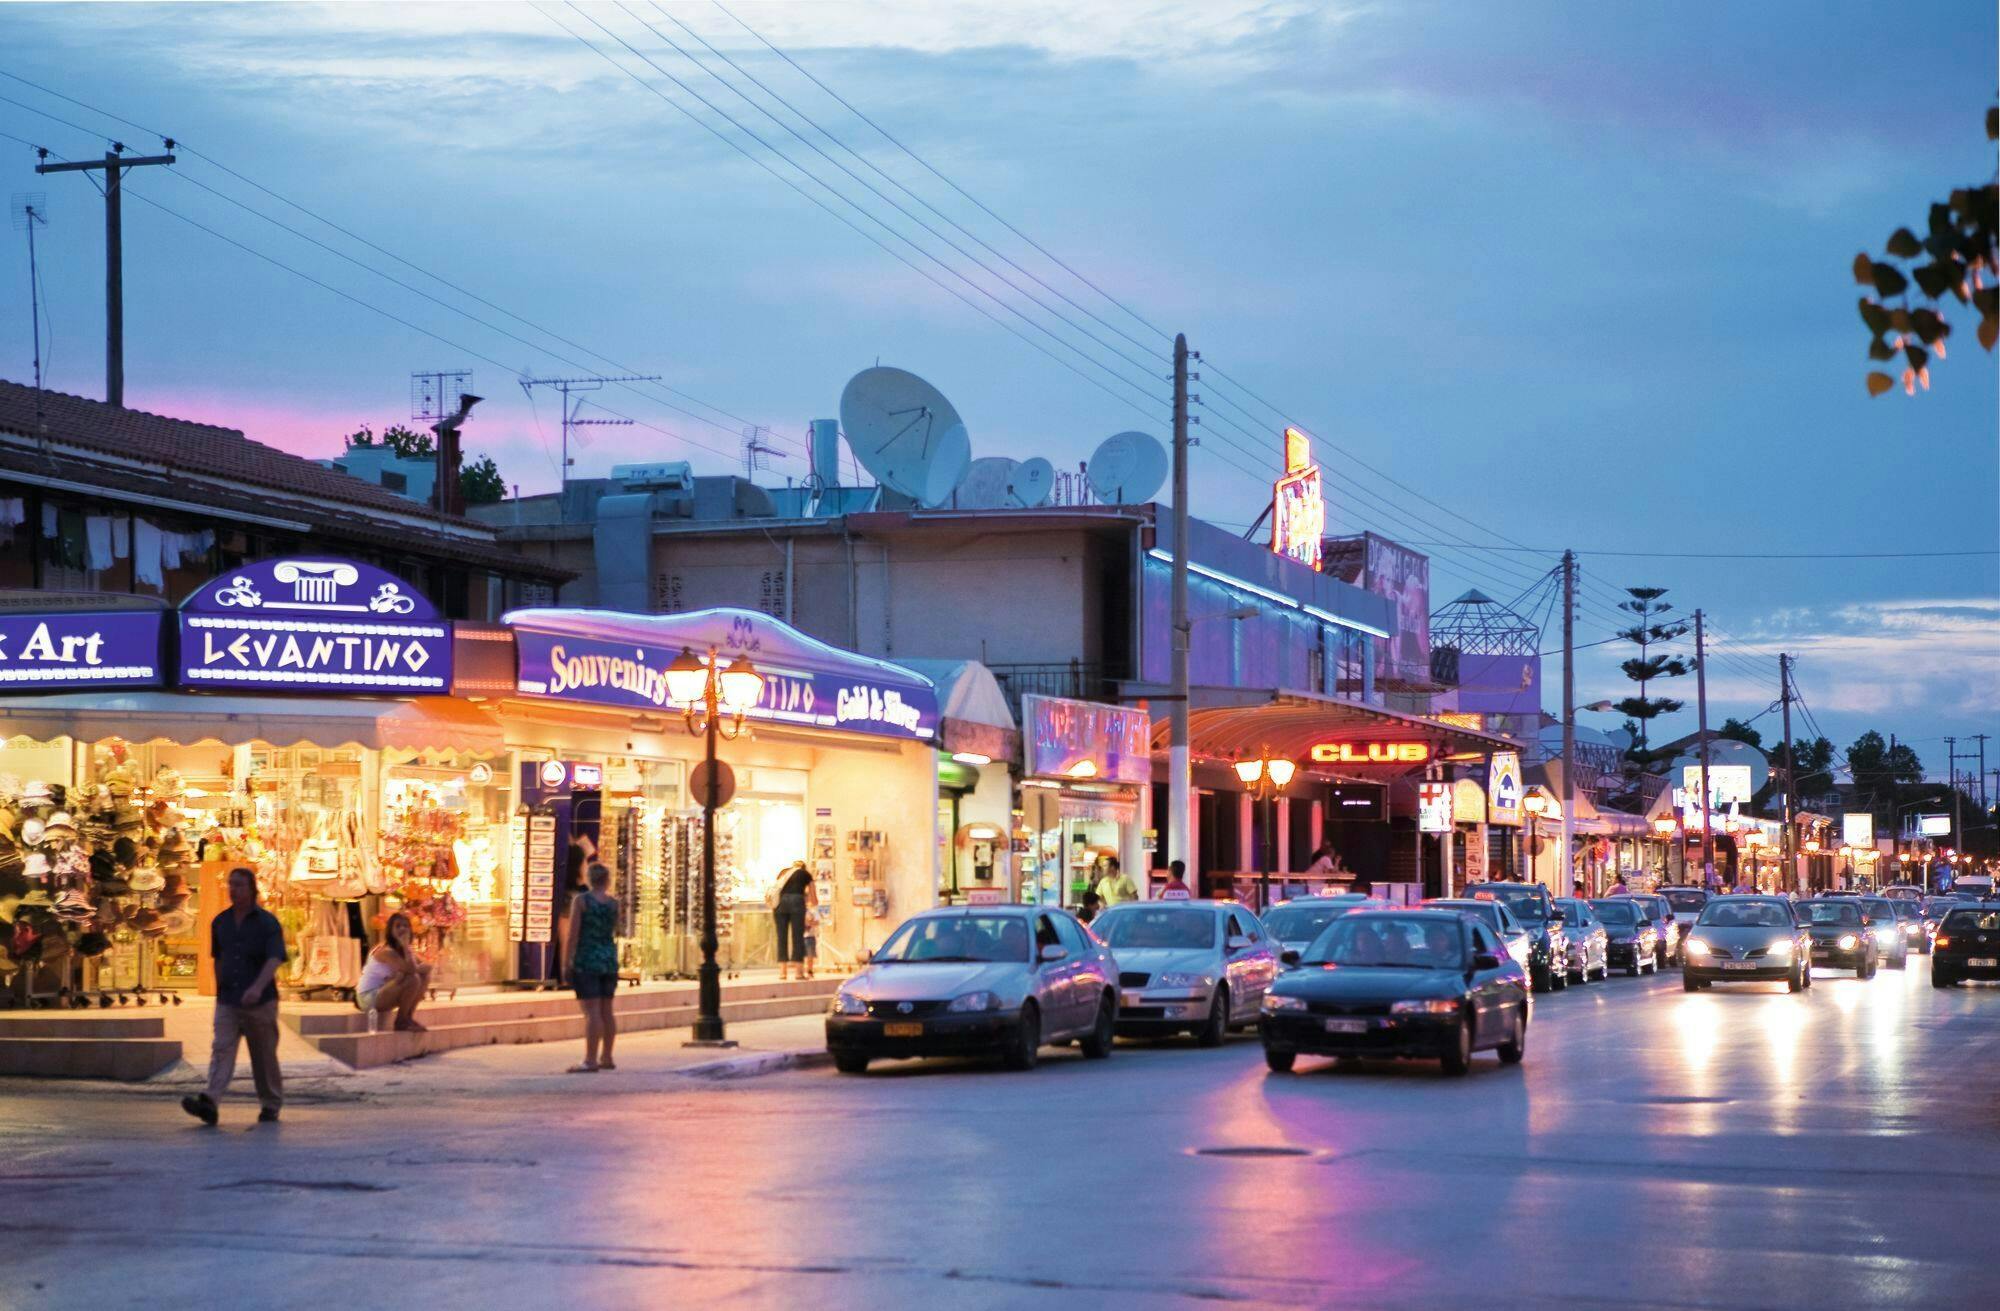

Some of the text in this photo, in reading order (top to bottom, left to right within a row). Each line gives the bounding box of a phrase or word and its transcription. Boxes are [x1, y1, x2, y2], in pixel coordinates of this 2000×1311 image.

[19, 622, 104, 665] Art
[204, 631, 430, 673] LEVANTINO
[550, 645, 666, 705] Souvenirs
[1311, 744, 1428, 762] CLUB
